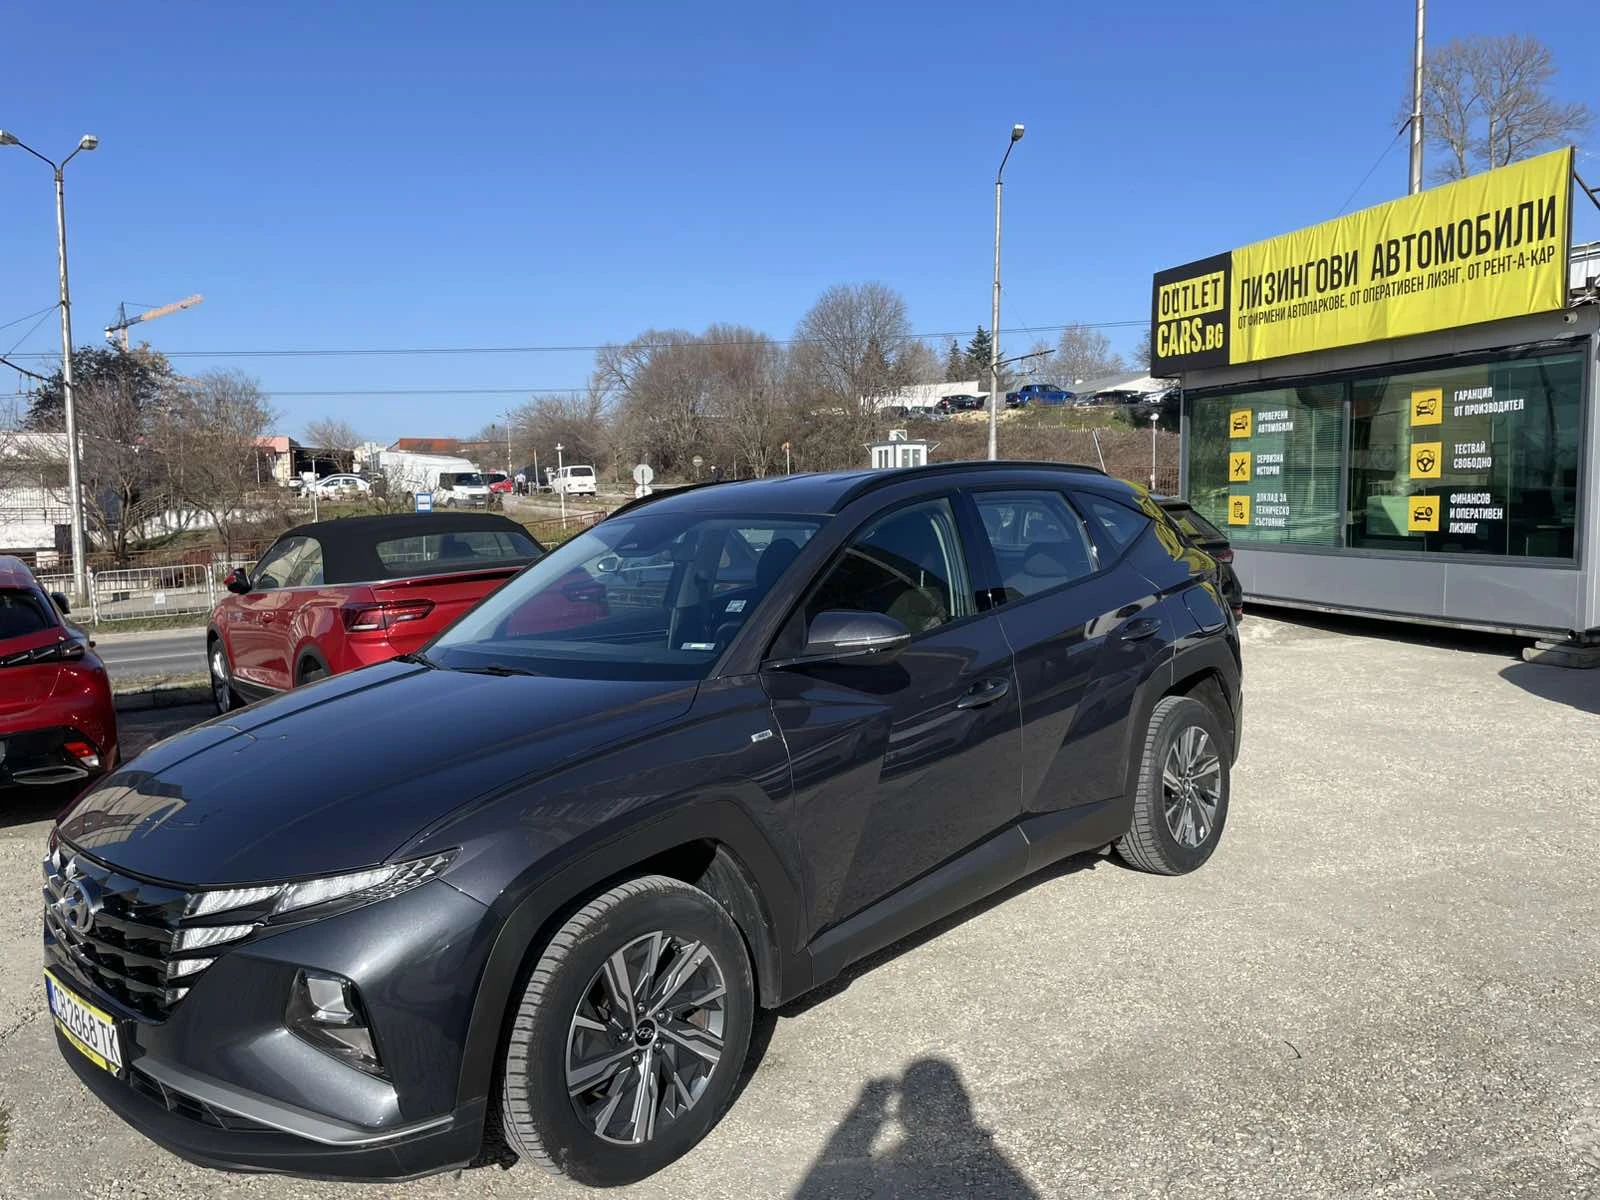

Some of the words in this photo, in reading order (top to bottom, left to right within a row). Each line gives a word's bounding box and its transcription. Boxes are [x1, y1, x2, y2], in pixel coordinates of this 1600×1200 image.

[1238, 250, 1358, 311] ЛИЗИНГОВИ
[1370, 195, 1556, 281] АВТОМОБИЛИ
[1238, 315, 1247, 330] ОТ
[1247, 307, 1285, 326] ФИРМЕНИ
[1287, 294, 1347, 319] АВТОПАРКОВЕ,
[1350, 290, 1361, 306] ОТ
[1363, 277, 1424, 303] ОПЕРАТИВЕН
[1467, 262, 1481, 280] ОТ
[1483, 245, 1555, 277] РЕНТ-А-КАР
[1162, 278, 1220, 316] OUTLET
[1157, 317, 1224, 359] CARS.BG
[1454, 387, 1493, 402] ГАРАНЦИЯ
[1453, 406, 1463, 417] ОТ
[1464, 399, 1524, 415] ПРОИЗВОДИТЕЛ
[1454, 441, 1486, 454] ТЕСТВАЙ
[1453, 456, 1492, 469] СВОБОДНО
[1450, 493, 1491, 505] ФИНАНСОВ
[1449, 508, 1455, 519] И
[1456, 507, 1503, 520] ОПЕРАТИВЕН
[1449, 522, 1478, 534] ЛИЗИНГ
